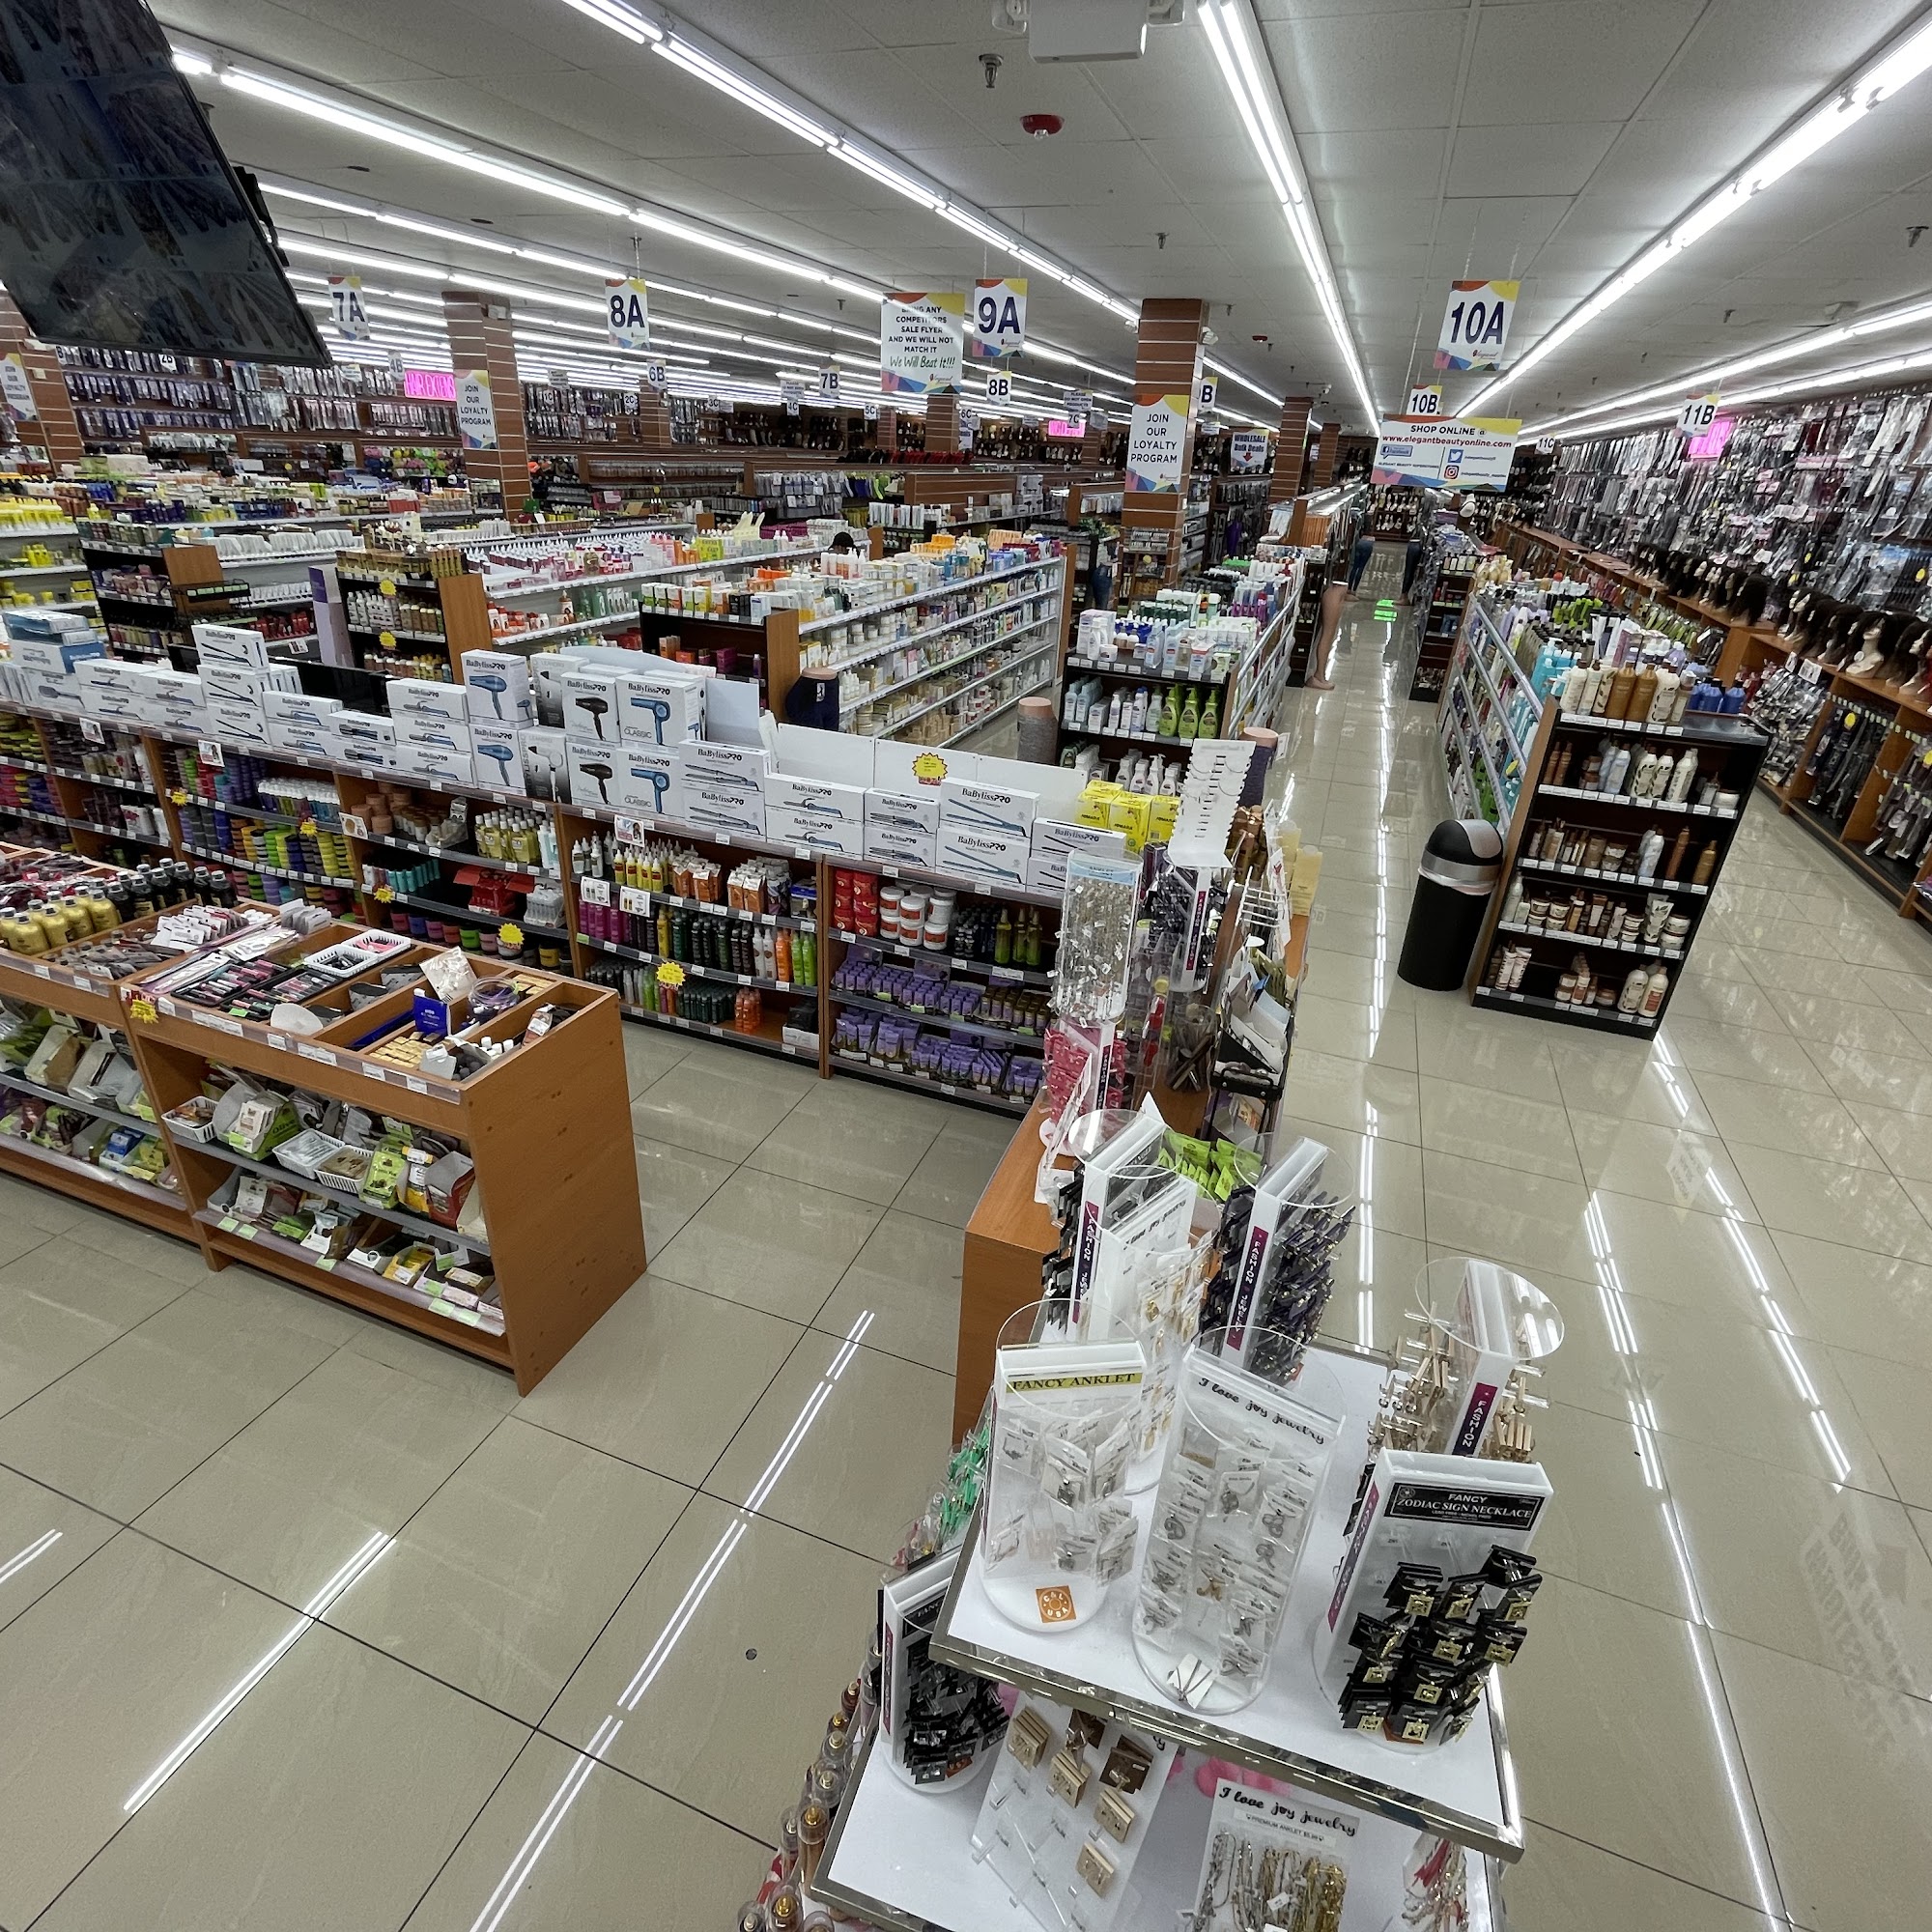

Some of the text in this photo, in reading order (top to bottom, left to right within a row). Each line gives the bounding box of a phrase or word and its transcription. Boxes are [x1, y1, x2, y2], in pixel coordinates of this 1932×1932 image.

[332, 292, 365, 323] 7A
[610, 295, 645, 328] 8A
[979, 297, 1021, 334] 9A
[1451, 301, 1504, 344] 10A
[389, 359, 403, 373] 4B
[890, 355, 902, 368] We
[904, 355, 919, 368] Will
[920, 356, 937, 369] Beat
[648, 366, 665, 383] 6B
[821, 373, 838, 389] 7B
[989, 379, 1009, 396] 8B
[1202, 385, 1213, 403] B
[1412, 394, 1437, 413] 10B
[1147, 413, 1169, 422] JOIN
[1684, 405, 1715, 425] 11B
[1147, 427, 1167, 436] OUR
[1410, 425, 1437, 434] SHOP
[1439, 426, 1475, 435] ONLINE
[1134, 440, 1177, 450] LOYALTY
[1235, 434, 1265, 442] WHOLESALE
[1382, 436, 1512, 447] www.elegantbeautyonline.com
[1539, 438, 1554, 447] 11C
[1131, 453, 1178, 463] PROGRAM
[567, 680, 606, 692] BaBylissPRO
[628, 682, 670, 696] BaBylissPRO
[628, 754, 669, 767] BaBylissPRO
[697, 749, 742, 761] BaBylissPRO
[792, 783, 832, 796] BaBylissPRO
[962, 788, 1010, 804] BaBylissPRO
[701, 791, 744, 806] BaBylissPRO
[794, 817, 833, 830] BaBylissPRO
[1055, 828, 1099, 842] BaBylissPRO
[957, 836, 1007, 851] BaBylissPRO
[1245, 1240, 1261, 1285] FASHION
[1013, 1373, 1136, 1390] FANCY ANKLET
[1199, 1378, 1324, 1444] I love joy jewelry
[1462, 1401, 1487, 1448] FASHION
[1448, 1493, 1488, 1504] FANCY
[1397, 1498, 1441, 1511] ZODIAC
[1441, 1502, 1470, 1513] SIGN
[1471, 1505, 1533, 1519] NECKLACE
[1047, 1606, 1068, 1618] USA
[1219, 1786, 1356, 1837] I love joy jewelry
[1252, 1816, 1278, 1828] PREMIUM
